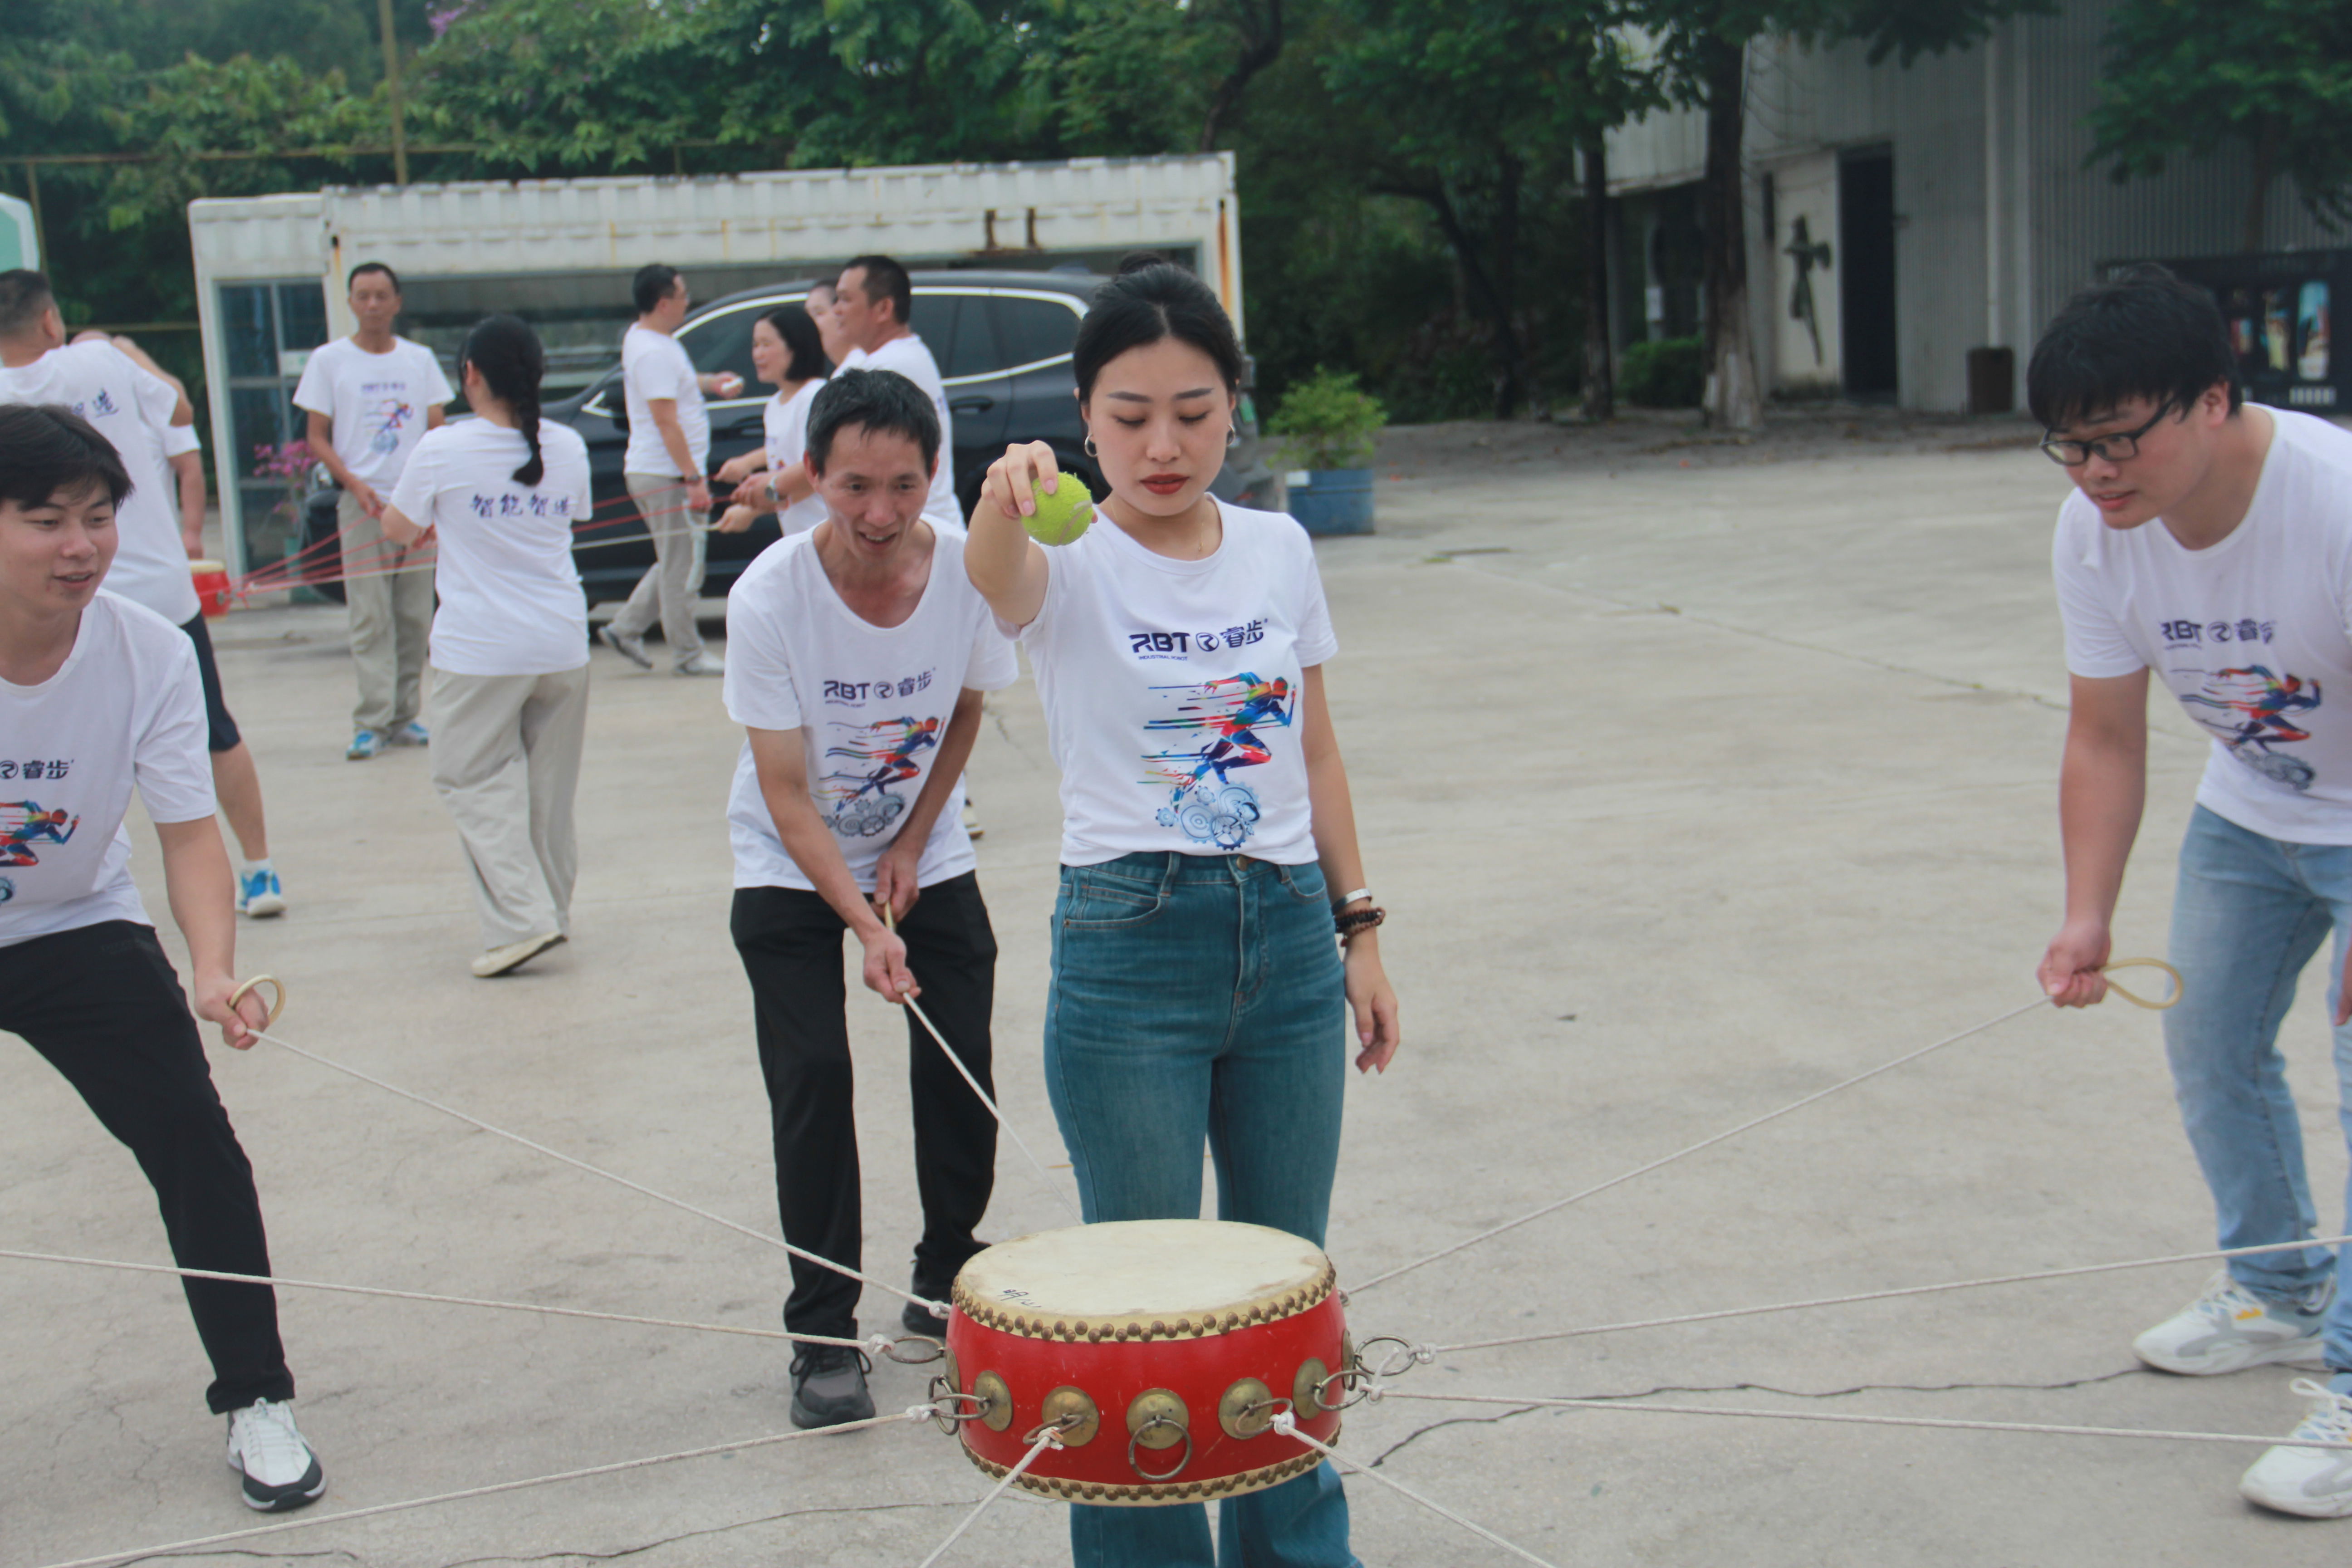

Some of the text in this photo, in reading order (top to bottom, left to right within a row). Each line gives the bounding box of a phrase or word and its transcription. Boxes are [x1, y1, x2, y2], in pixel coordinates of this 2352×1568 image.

[1128, 618, 1264, 653] RBT 睿步
[823, 671, 932, 700] RBT 睿步
[23, 760, 69, 779] 睿步
